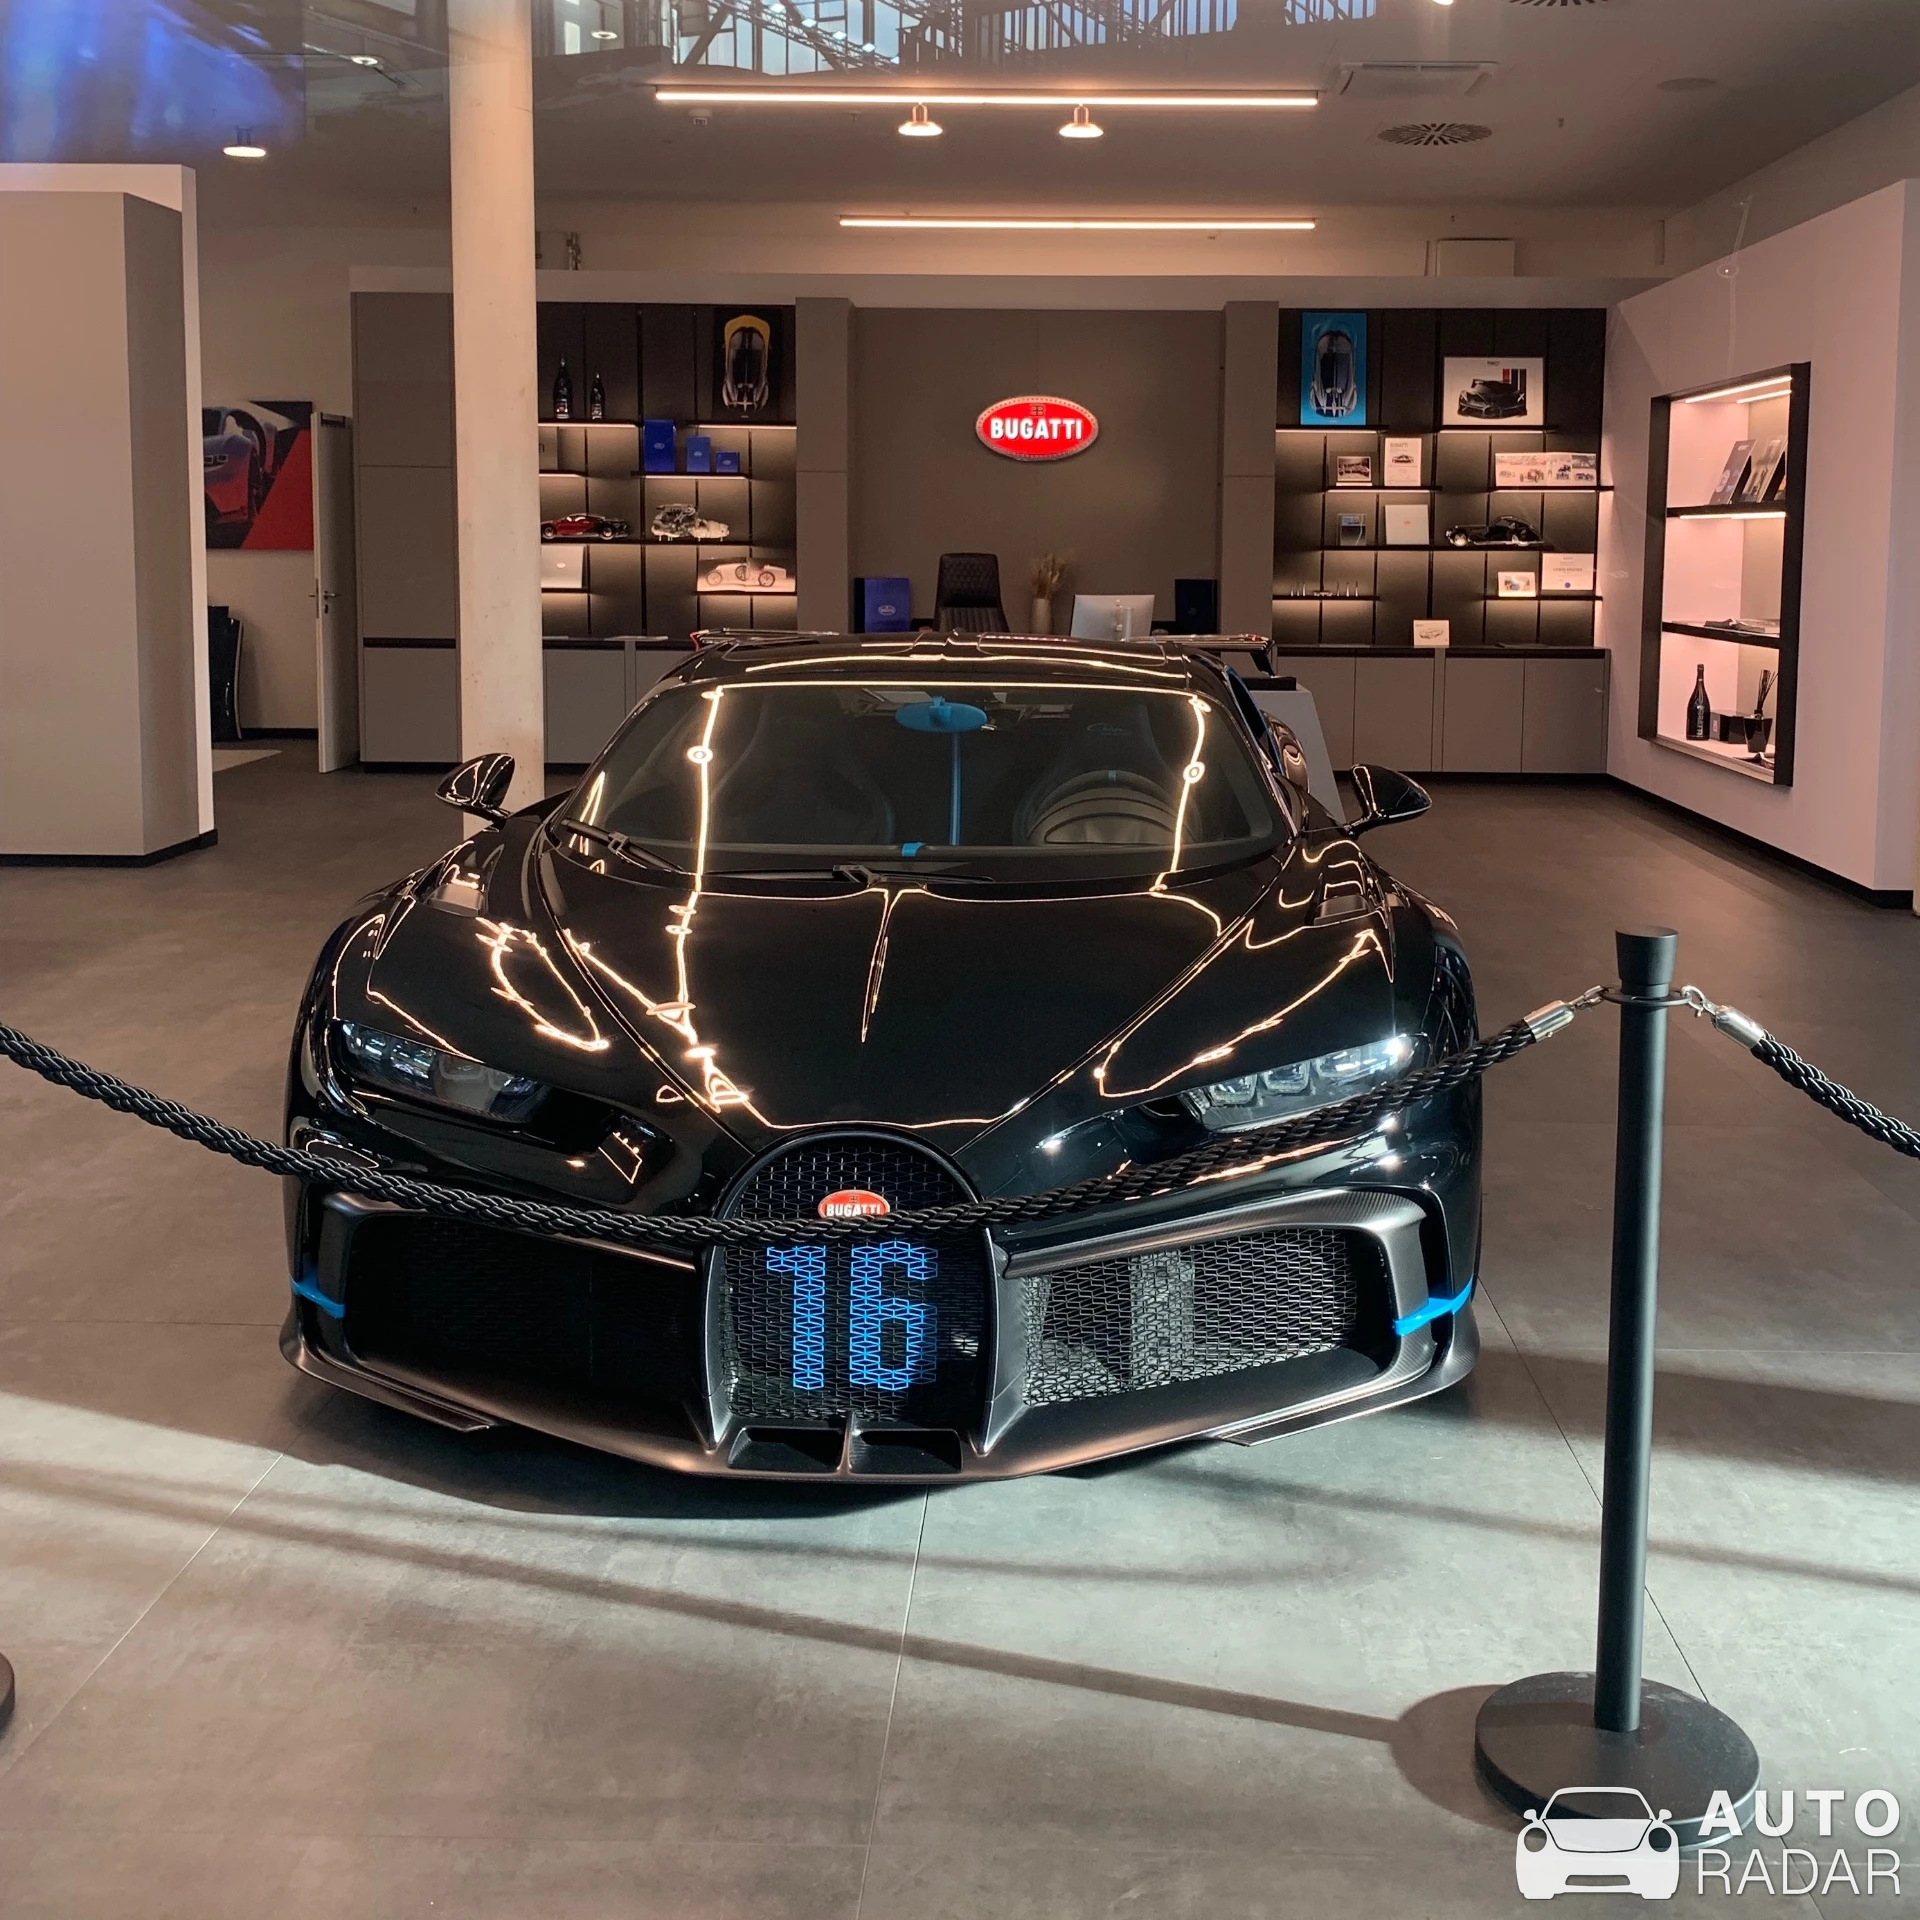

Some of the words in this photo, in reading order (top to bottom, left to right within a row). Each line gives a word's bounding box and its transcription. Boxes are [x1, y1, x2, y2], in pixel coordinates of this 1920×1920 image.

[990, 418, 1082, 440] BUGATTI
[826, 1203, 881, 1217] BUGATTI
[766, 1240, 938, 1391] 16
